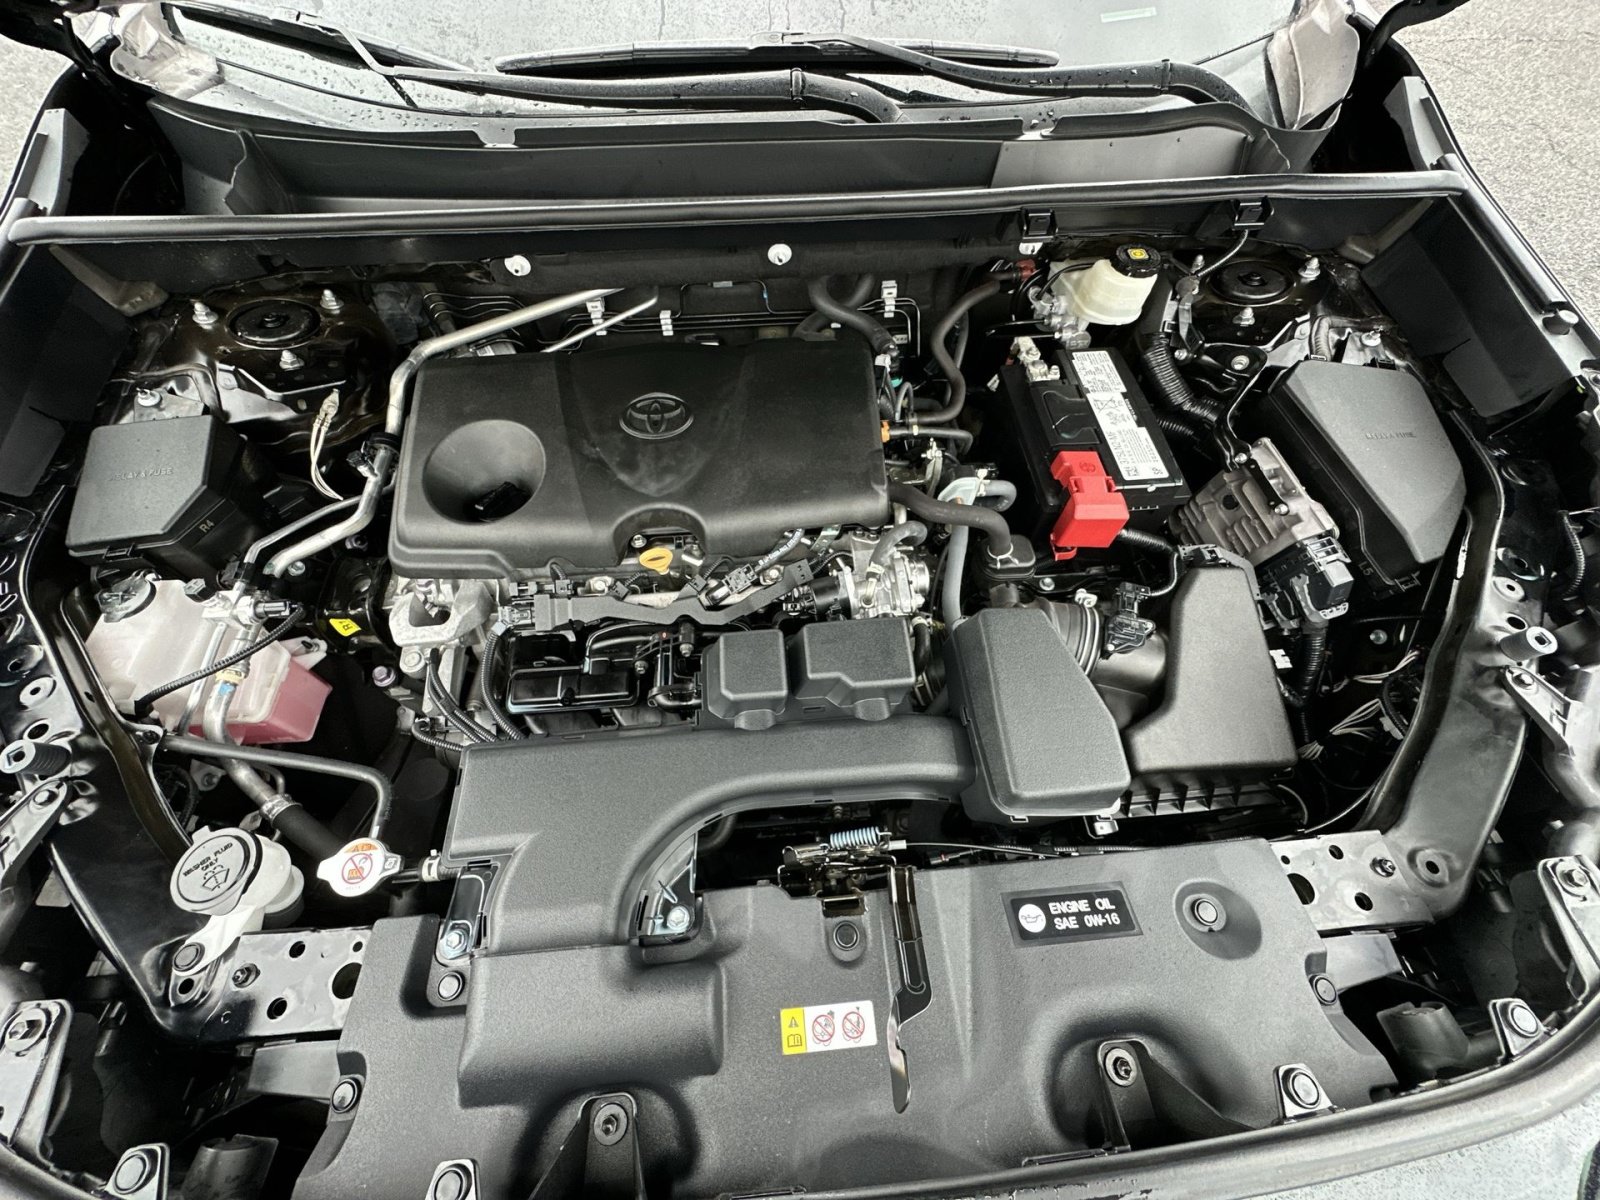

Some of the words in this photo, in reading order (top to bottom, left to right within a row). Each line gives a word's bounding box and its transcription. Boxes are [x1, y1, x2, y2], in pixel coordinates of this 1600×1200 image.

[199, 519, 215, 533] R4
[201, 857, 219, 871] ONLY
[1048, 899, 1092, 915] ENGINE
[1095, 897, 1116, 910] OIL
[1054, 916, 1079, 930] SAE
[1084, 912, 1121, 928] 0W-16
